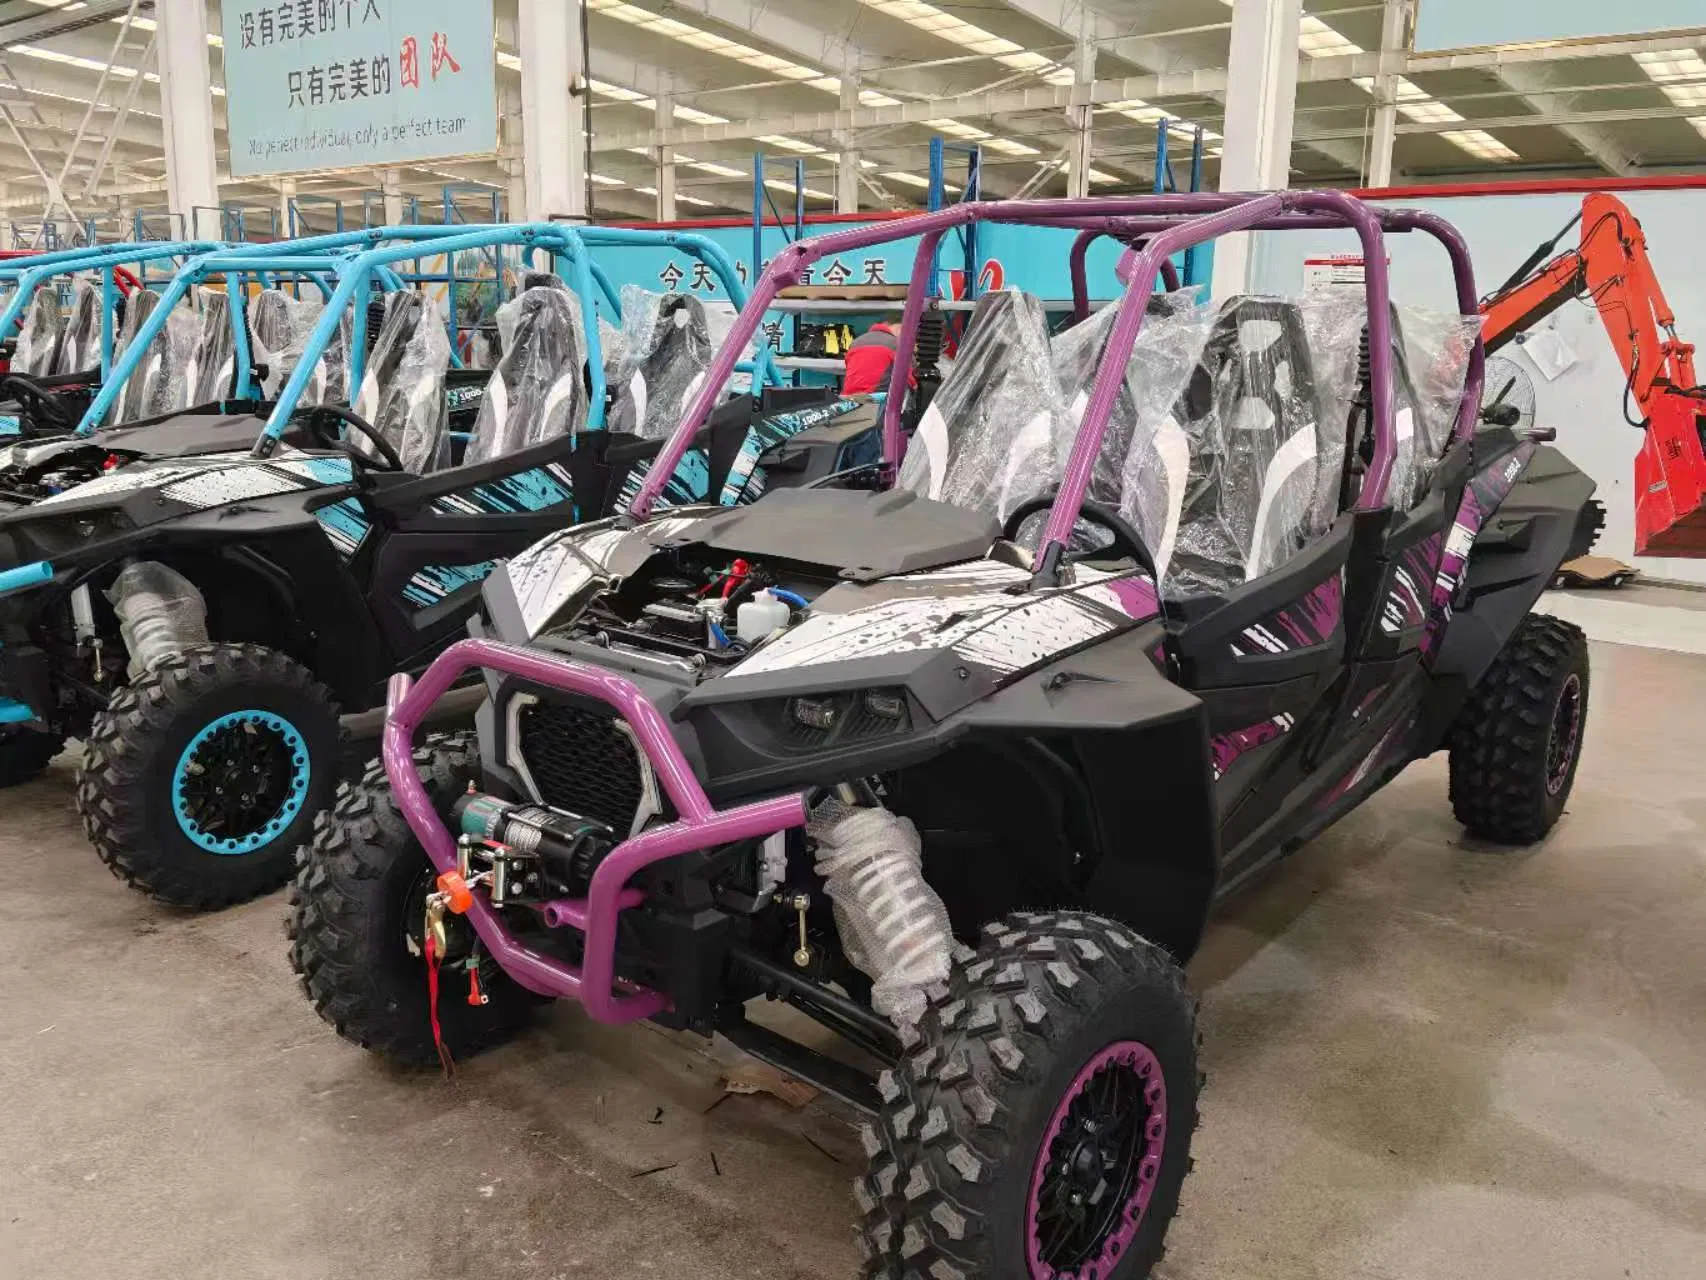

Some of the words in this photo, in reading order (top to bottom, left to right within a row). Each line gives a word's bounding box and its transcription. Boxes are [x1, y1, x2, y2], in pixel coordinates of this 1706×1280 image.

[239, 0, 381, 49] 没有完美的个人
[288, 31, 461, 109] 只有完美的团队
[355, 122, 378, 149] only
[382, 126, 390, 141] a
[436, 115, 468, 135] team
